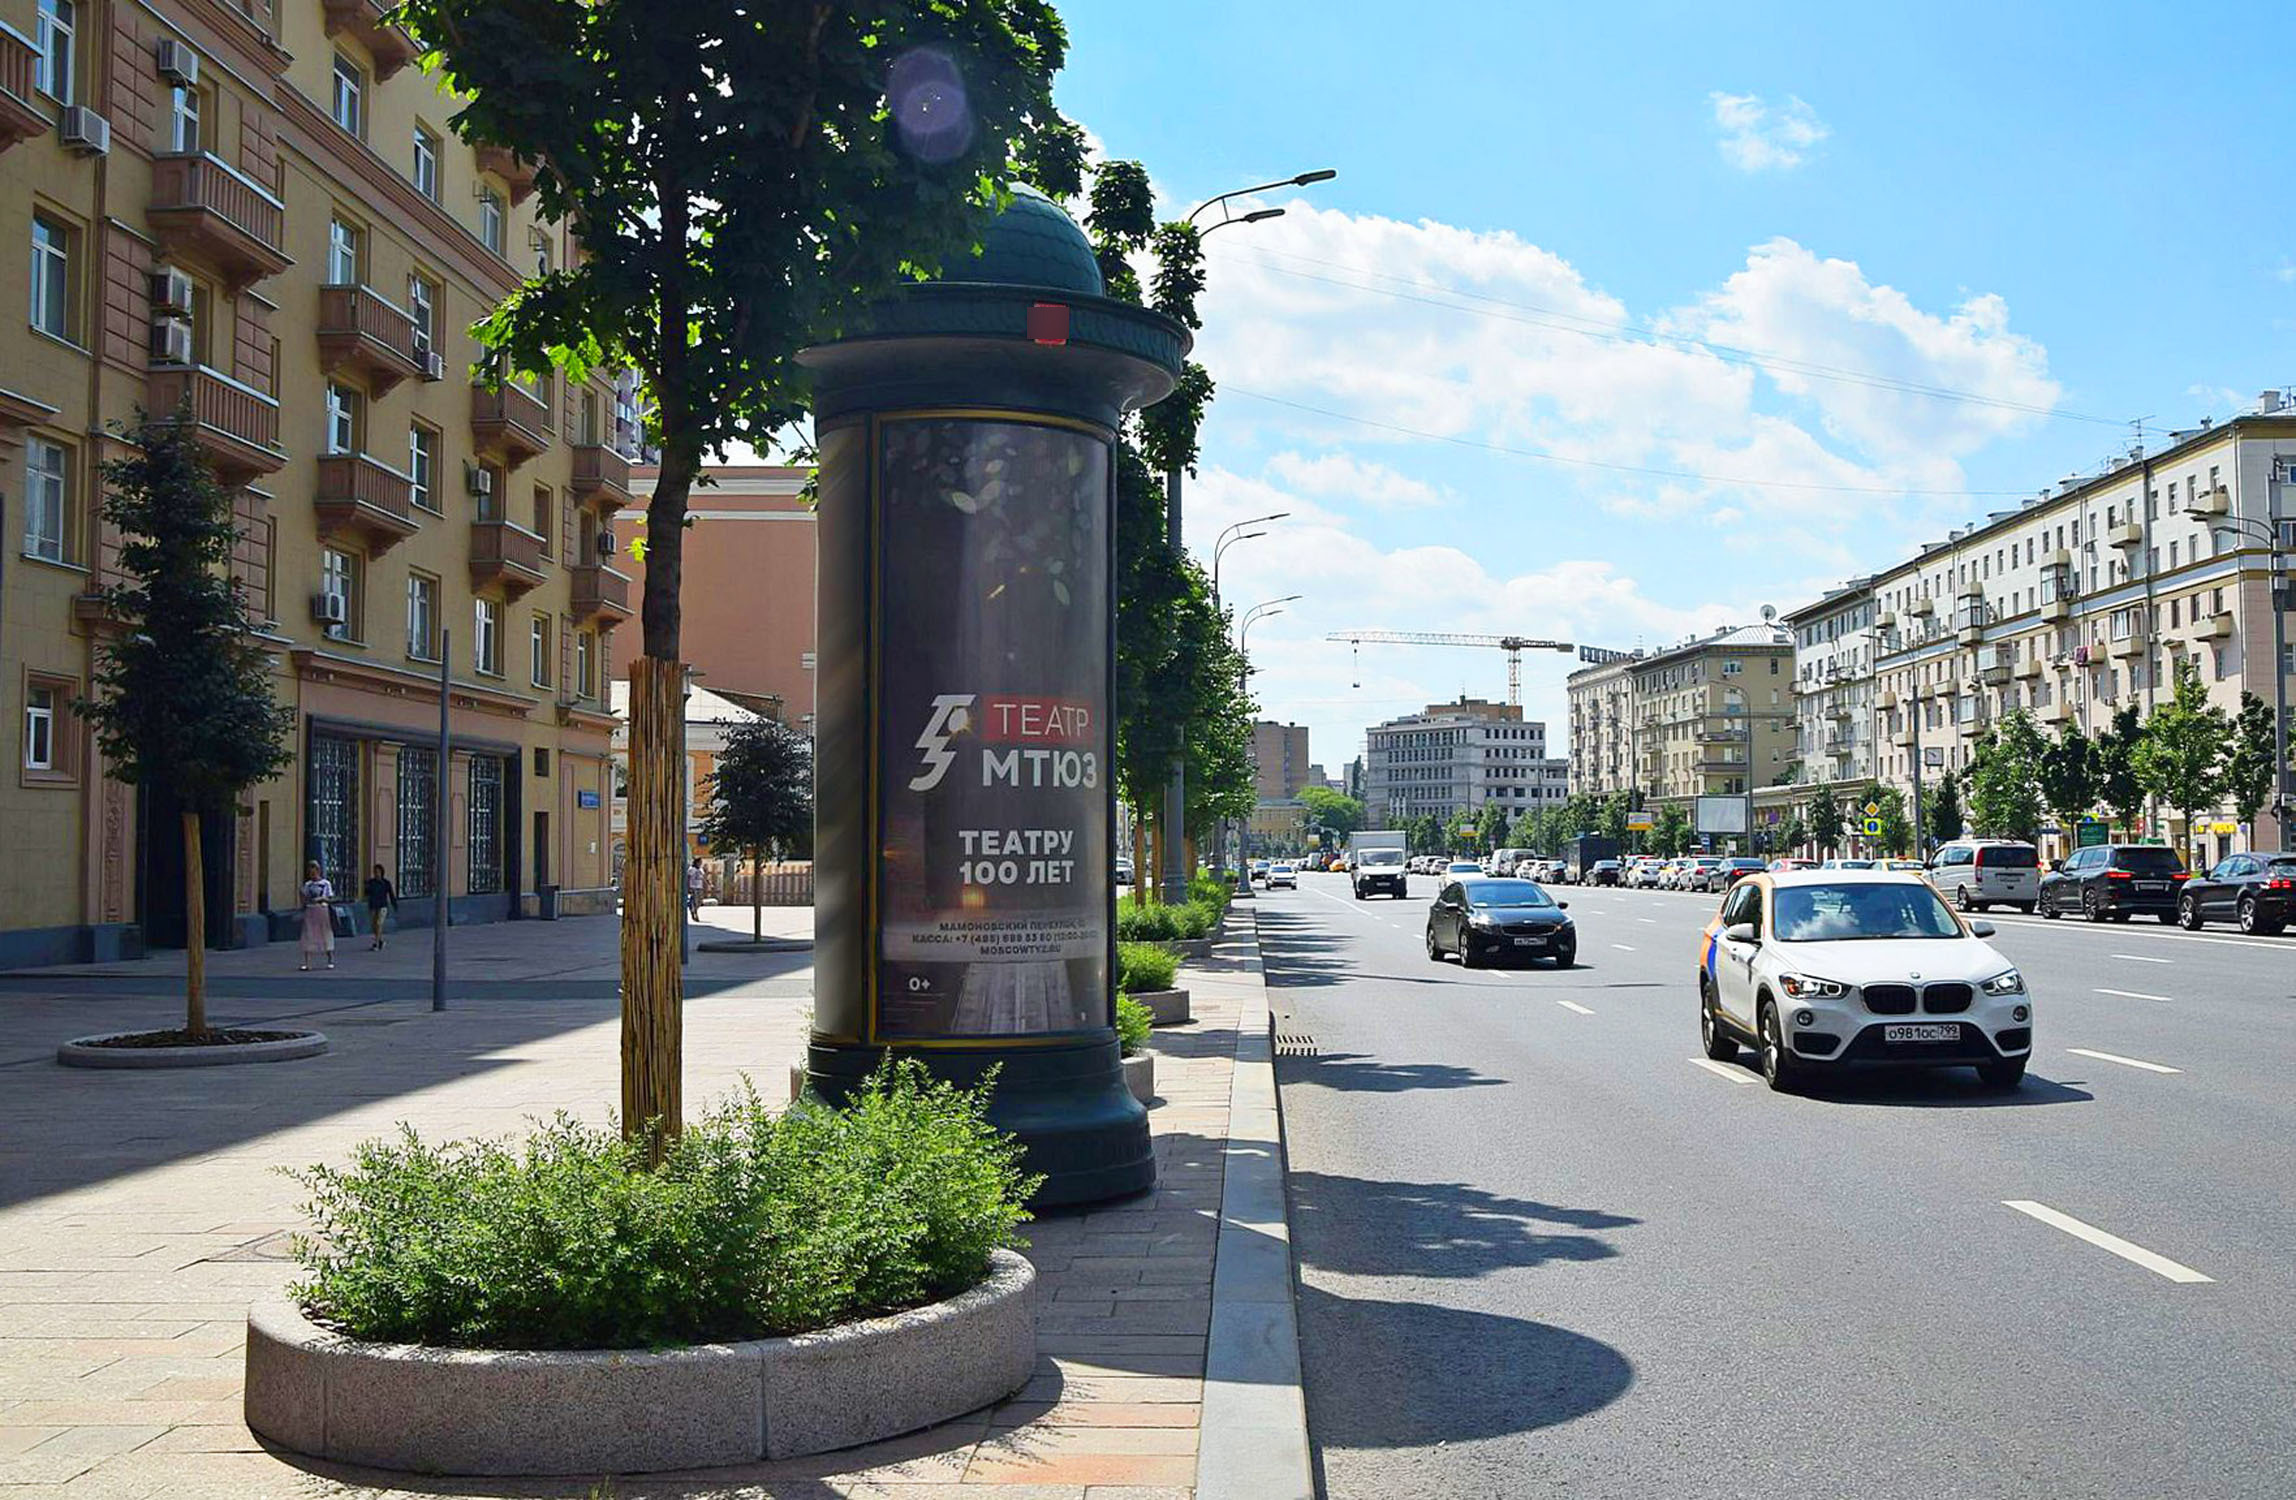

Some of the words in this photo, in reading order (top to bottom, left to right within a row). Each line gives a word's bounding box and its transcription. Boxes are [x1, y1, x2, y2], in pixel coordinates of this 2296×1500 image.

[993, 703, 1090, 738] ТЕАТР
[982, 749, 1098, 789] МТЮЗ
[958, 830, 1075, 856] ТЕАТРУ
[958, 860, 1018, 886] 100
[1026, 860, 1075, 885] ЛЕТ
[912, 933, 953, 944] КАССА:
[908, 976, 931, 991] 0+
